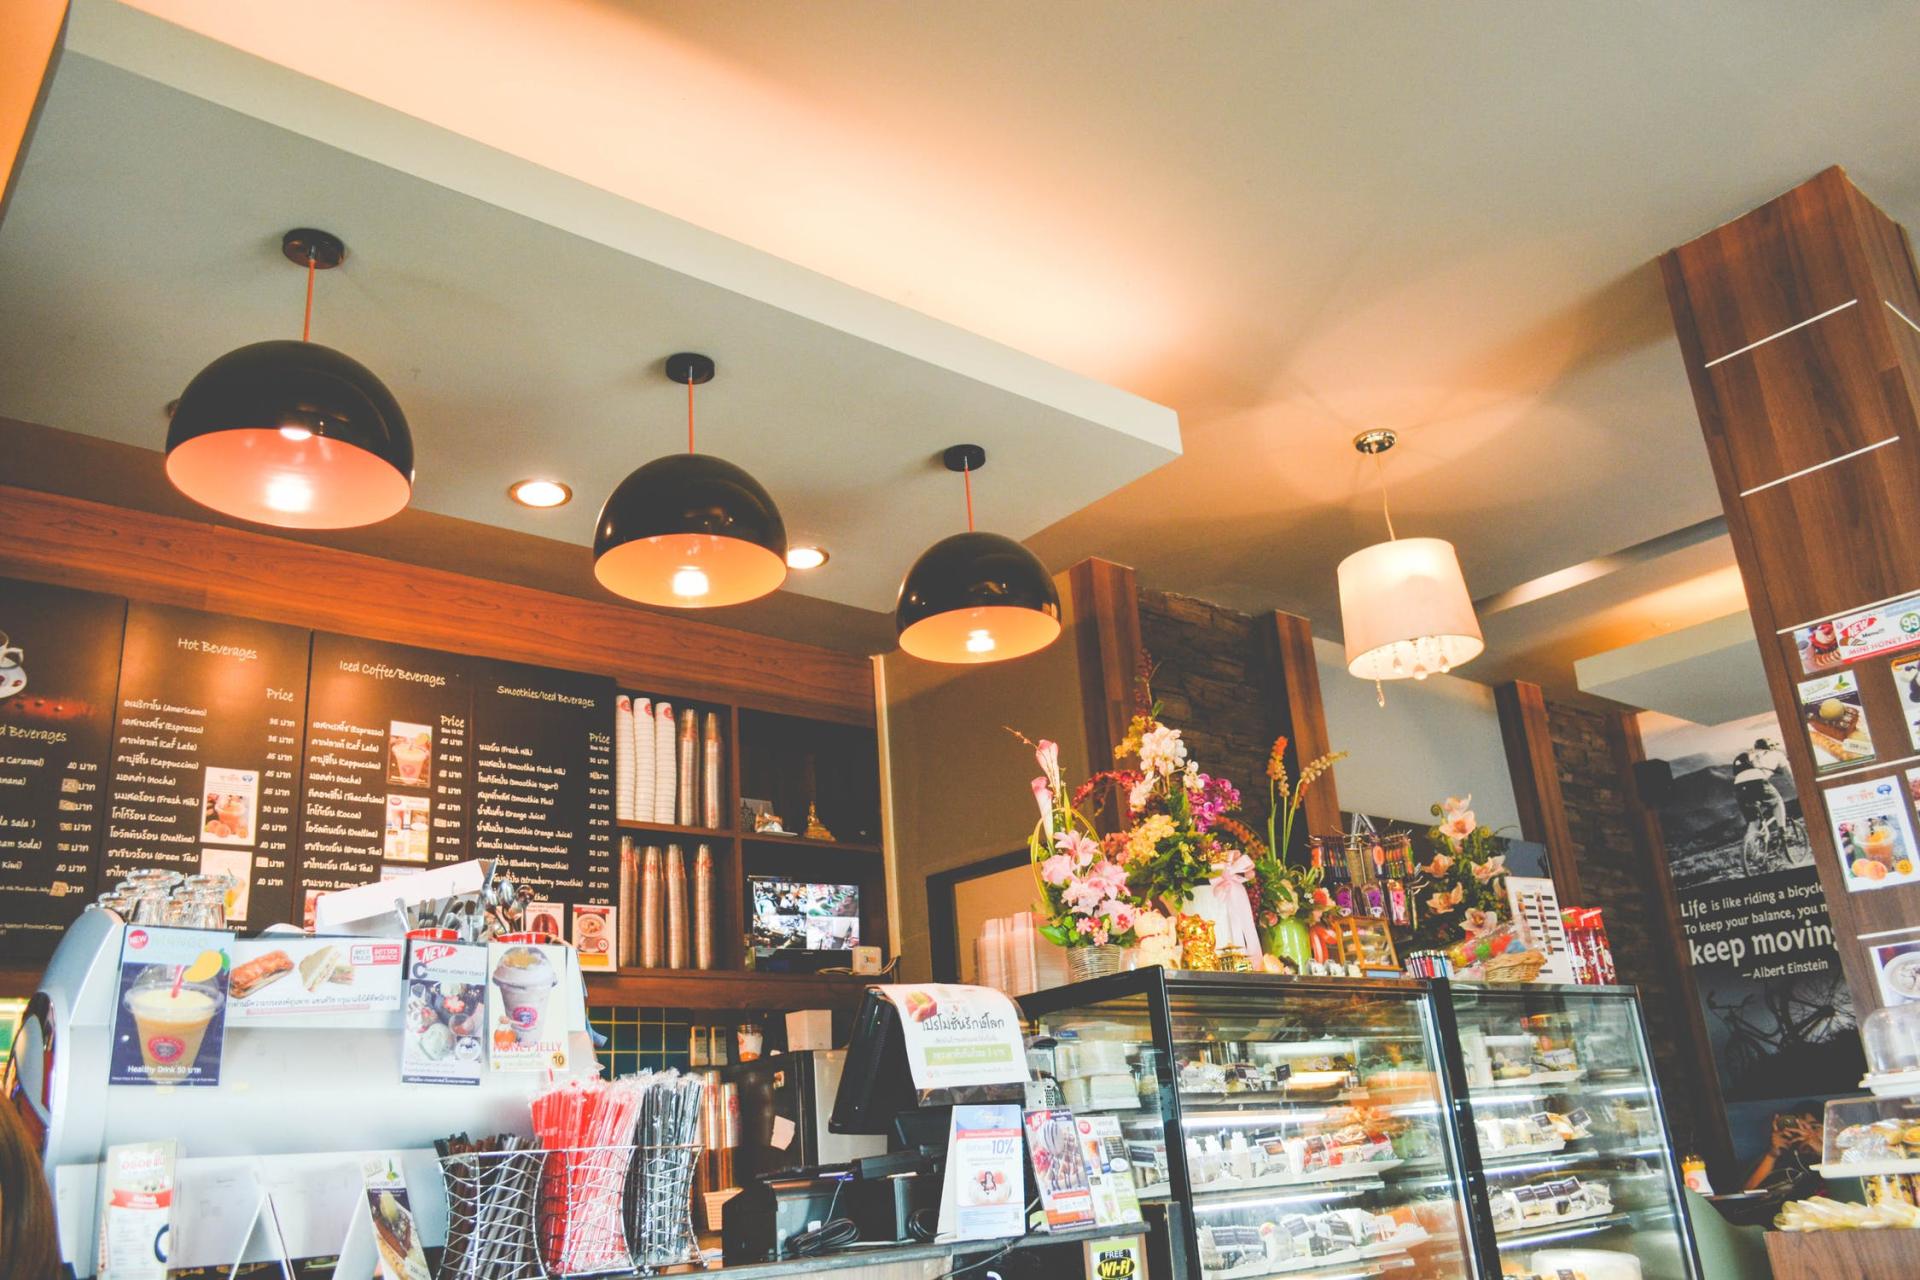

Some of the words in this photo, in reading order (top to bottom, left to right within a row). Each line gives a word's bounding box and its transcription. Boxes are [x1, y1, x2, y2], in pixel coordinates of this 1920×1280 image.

[1902, 616, 1918, 630] 99
[177, 638, 199, 650] Hot
[201, 641, 257, 662] Beverages
[340, 661, 360, 673] Iced
[362, 664, 446, 688] Coffee/Beverages
[266, 688, 294, 702] Price
[497, 686, 557, 701] Smoothies/Iced
[558, 694, 596, 708] Beverages
[163, 704, 207, 716] (Americano)
[280, 718, 295, 728] บาท
[440, 715, 465, 728] Price
[8, 726, 67, 744] Beverages
[589, 732, 611, 744] Price
[279, 736, 294, 745] บาท
[449, 738, 463, 747] บาท
[278, 754, 293, 762] บาท
[449, 754, 463, 763] บาท
[79, 762, 97, 771] บาท
[276, 771, 291, 780] บาท
[448, 770, 462, 779] บาท
[78, 782, 96, 792] บาท
[448, 786, 462, 795] บาท
[275, 789, 290, 797] บาท
[75, 803, 93, 812] บาท
[273, 806, 289, 815] บาท
[447, 803, 461, 812] บาท
[148, 813, 177, 824] (Cocoa)
[73, 822, 91, 832] บาท
[272, 824, 287, 833] บาท
[447, 820, 461, 828] บาท
[446, 836, 460, 845] บาท
[71, 843, 89, 852] บาท
[270, 843, 286, 851] บาท
[445, 853, 459, 861] บาท
[68, 864, 86, 874] บาท
[269, 860, 285, 869] บาท
[268, 879, 283, 887] บาท
[66, 885, 84, 894] บาท
[1680, 900, 1708, 919] Life
[1711, 900, 1720, 911] is
[1722, 896, 1742, 909] like
[1743, 892, 1776, 906] riding
[1778, 890, 1785, 900] a
[1683, 924, 1697, 935] To
[1699, 920, 1723, 933] keep
[1725, 916, 1749, 932] your
[1751, 909, 1796, 924] balance,
[1797, 906, 1818, 920] you
[129, 935, 148, 945] NEW
[423, 946, 448, 963] NEW
[1688, 938, 1746, 968] keep
[1788, 959, 1829, 975] Einstein
[536, 1041, 562, 1052] JELLY
[128, 1066, 156, 1075] Healthy
[992, 1139, 1014, 1155] 10%
[1105, 1250, 1124, 1259] FREE
